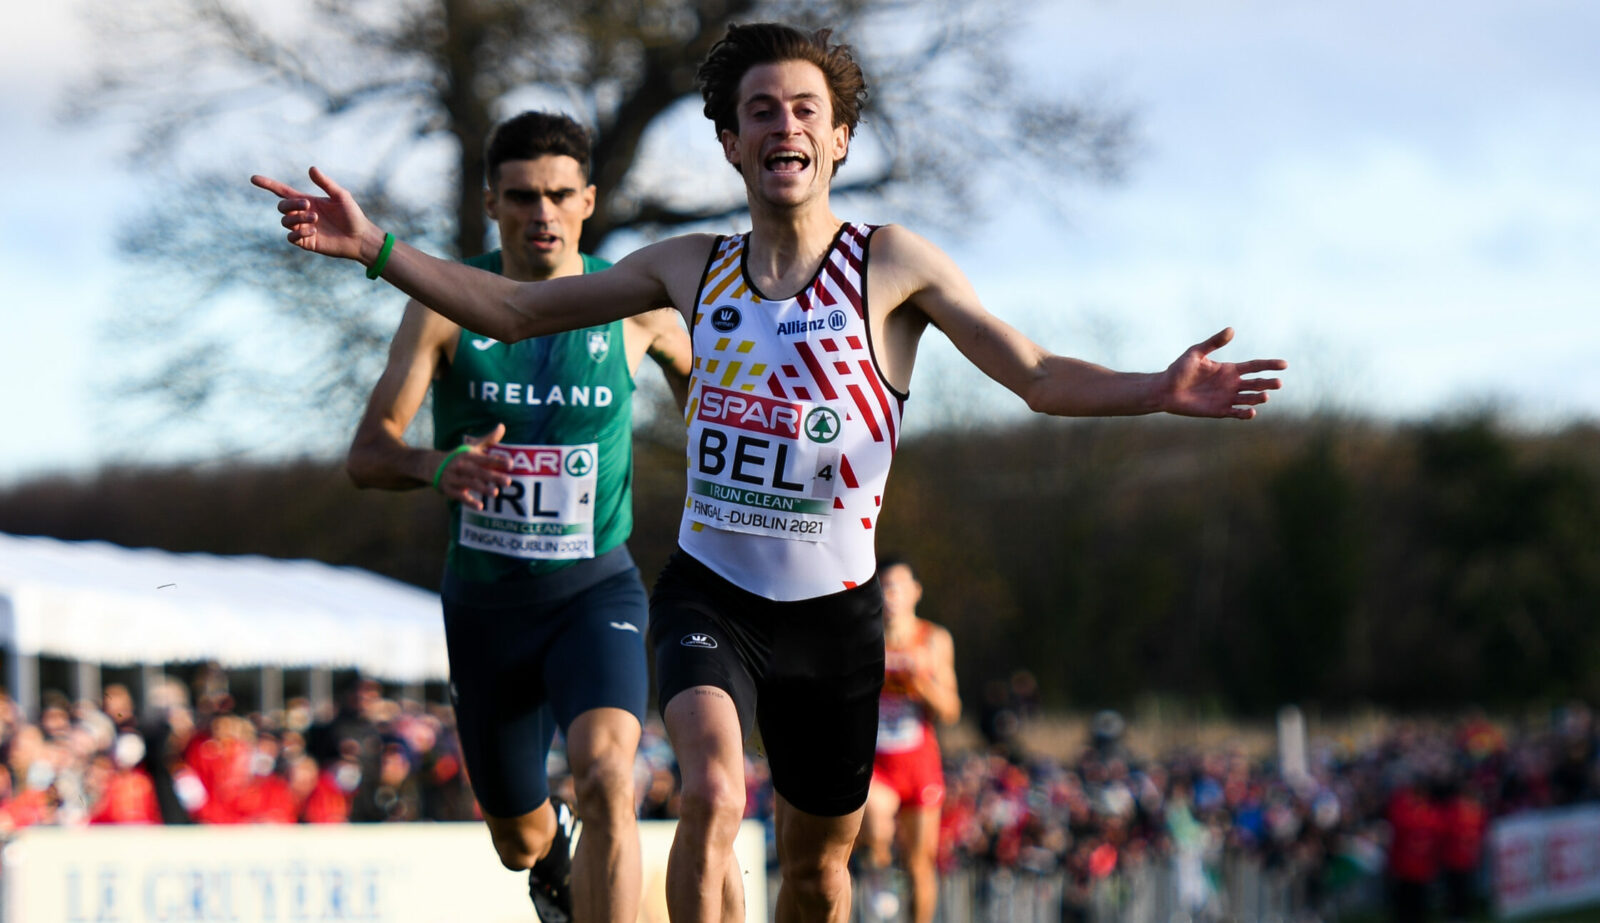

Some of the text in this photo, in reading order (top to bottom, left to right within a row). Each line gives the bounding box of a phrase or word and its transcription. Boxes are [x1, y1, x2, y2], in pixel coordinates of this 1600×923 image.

[776, 318, 825, 336] Allianz
[469, 381, 613, 407] IRELAND
[701, 391, 799, 434] SPAR
[698, 428, 804, 492] BEL
[817, 464, 833, 481] 4
[578, 492, 589, 505] 4
[714, 485, 741, 502] RUN
[491, 520, 518, 531] RUN
[693, 500, 823, 535] FINGAL-DUBLIN 2021
[464, 528, 588, 553] FINGAL-DUBLIN 2021
